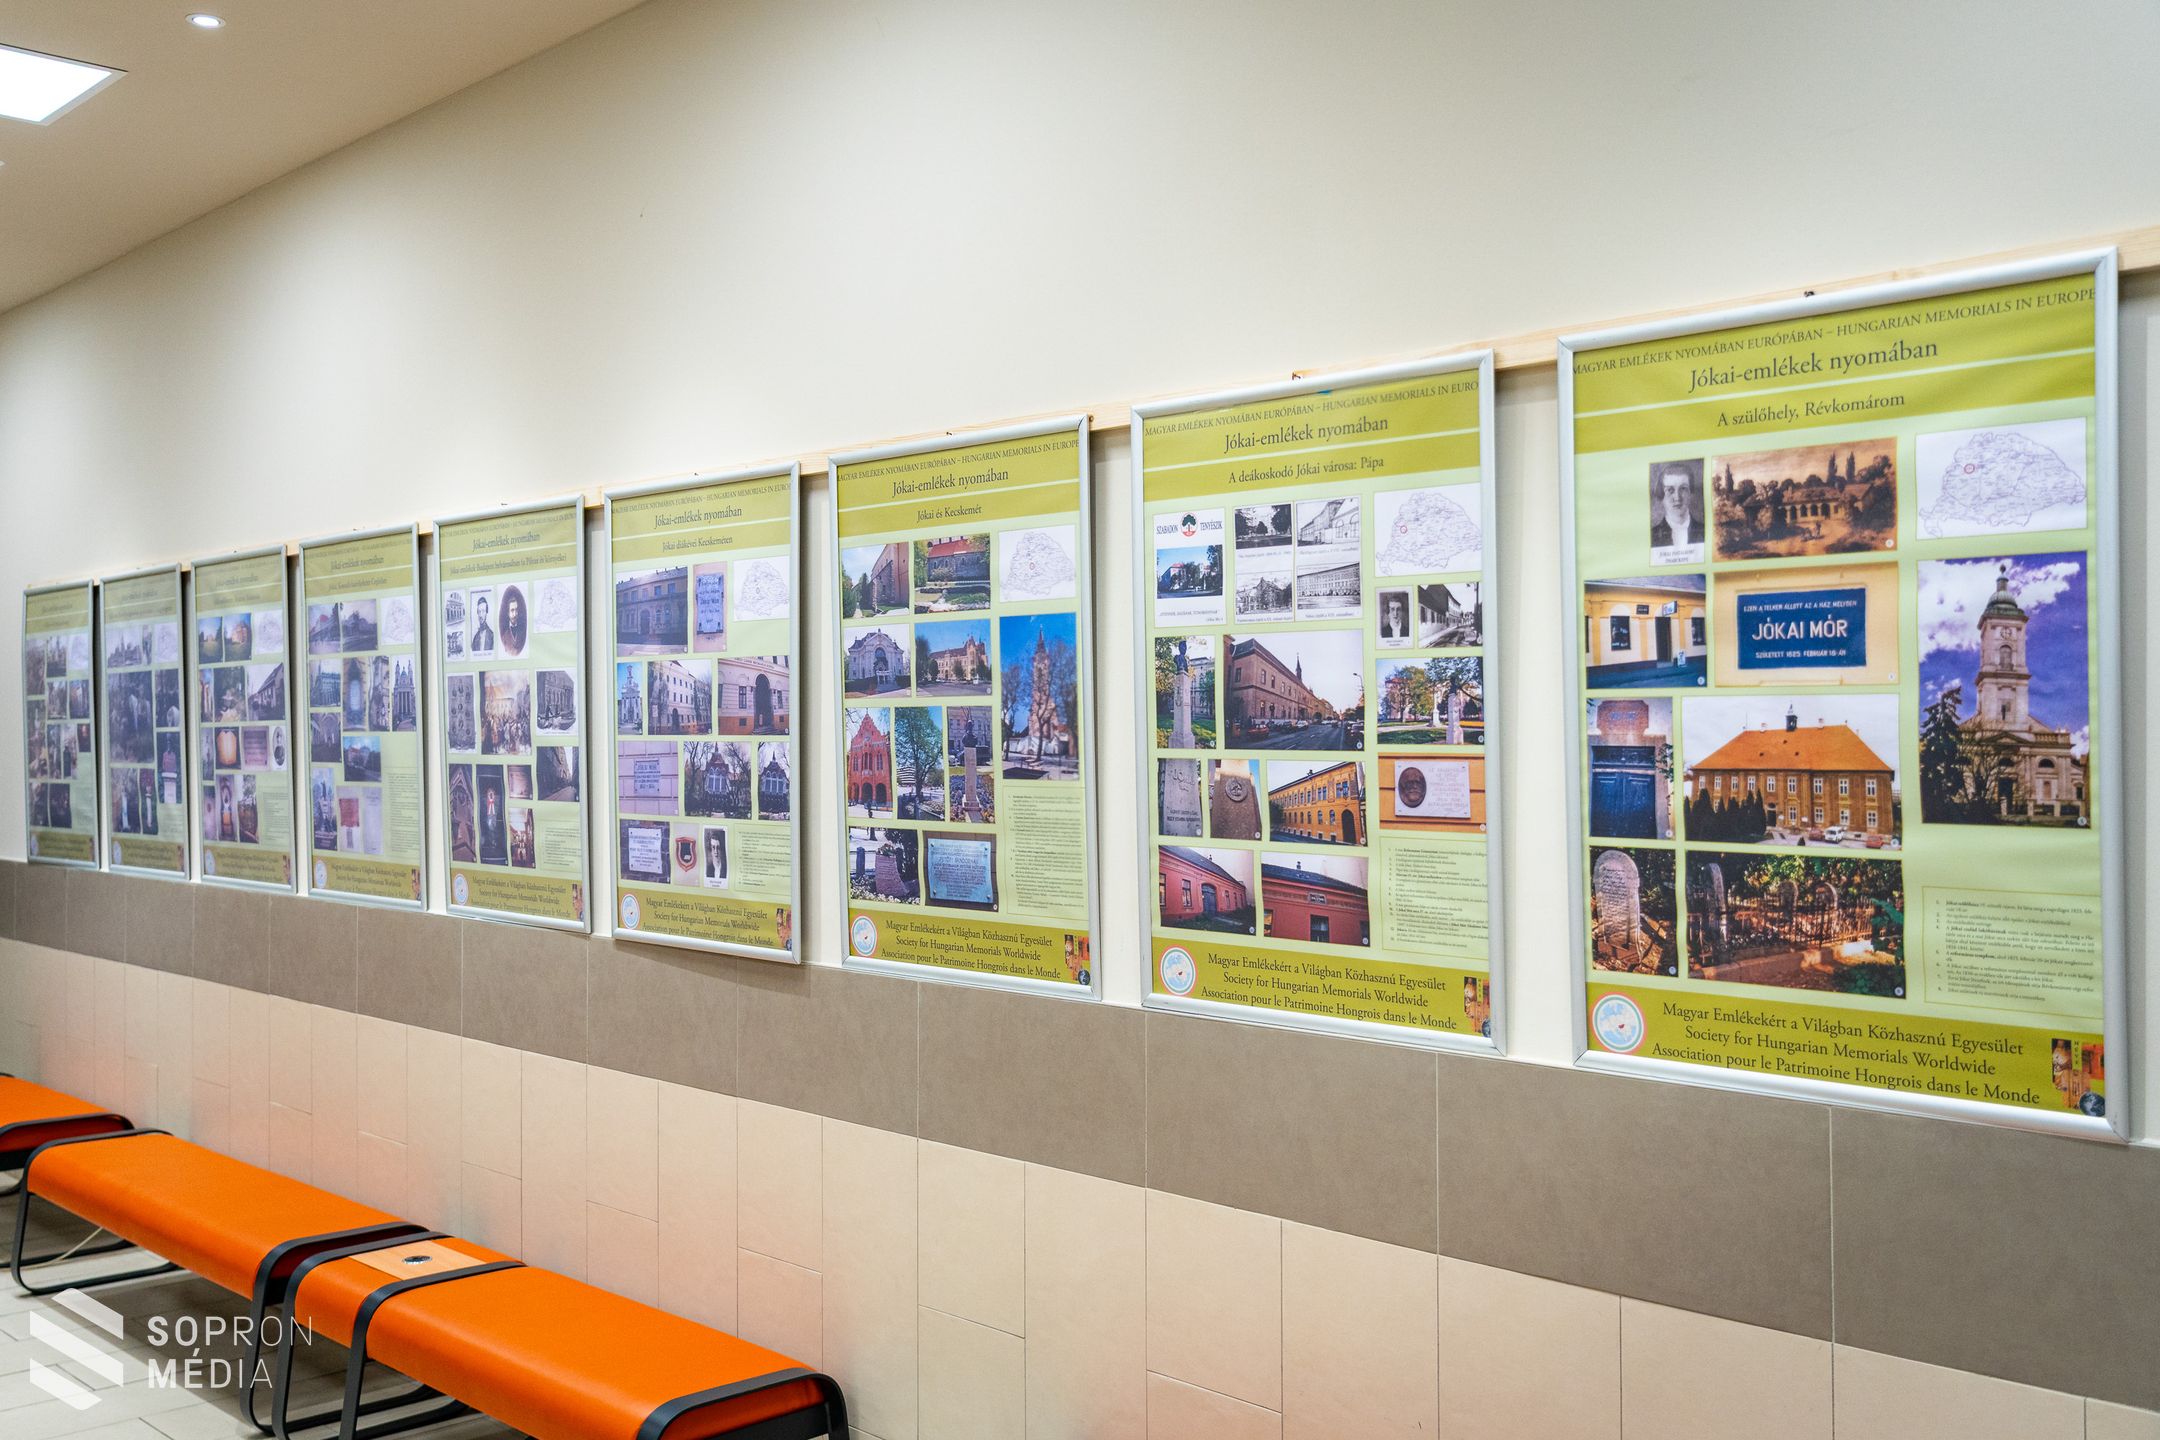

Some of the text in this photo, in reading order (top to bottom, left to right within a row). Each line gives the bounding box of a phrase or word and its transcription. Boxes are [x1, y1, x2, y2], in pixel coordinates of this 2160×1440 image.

[1573, 357, 1616, 375] MAGYAR
[1619, 349, 1672, 369] EMLÉKEK
[1675, 339, 1744, 360] NYOMÁBAN
[1747, 328, 1823, 350] EURÓPÁBAN
[1837, 314, 1921, 338] HUNGARIAN
[1926, 300, 2011, 323] MEMORIALS
[2016, 297, 2032, 311] IN
[2036, 288, 2095, 307] EUROPE
[1688, 339, 1938, 393] Jókai-emlékek nyomában
[1145, 424, 1176, 436] MAGYAR
[1178, 418, 1214, 431] EMLÉKEK
[1215, 411, 1262, 426] NYOMÁBAN
[1264, 405, 1314, 420] EURÓPÁBAN
[1322, 394, 1377, 412] HUNGARIAN
[1380, 386, 1436, 403] MEMORIALS
[1438, 385, 1448, 395] IN
[1717, 394, 1905, 427] A szülőhely, Révkomárom
[1224, 416, 1388, 454] Jókai-emlékek nyomában
[859, 468, 884, 479] EMLÉKEK
[885, 463, 919, 475] NYOMÁBAN
[961, 451, 1000, 463] HUNGARIAN
[1002, 445, 1042, 457] MEMORIALS
[1043, 443, 1050, 452] IN
[1228, 456, 1384, 483] A deákoskodó Jókai városa: Pápa
[892, 468, 1009, 498] Jókai-emlékek nyomában
[653, 505, 742, 529] Jókai-emlékek nyomában
[916, 503, 982, 523] Jókai és Kecskemét
[1752, 614, 1847, 640] JÓKAI MÓR
[885, 920, 908, 933] Magyar
[910, 922, 945, 935] Emlékekért
[951, 926, 980, 940] Világban
[982, 929, 1018, 943] Közhasznú
[1020, 933, 1052, 947] Egyesület
[896, 935, 1041, 960] Society for Hungarian Memorials Worldwide
[881, 948, 1061, 978] Association pour le Patrimoine Hongrois dans le Monde
[1208, 953, 1239, 968] Magyar
[1242, 956, 1291, 973] Emlékekért
[1301, 963, 1342, 980] Világban
[1345, 968, 1396, 985] Közhasznú
[1399, 974, 1446, 990] Egyesület
[1223, 972, 1428, 1007] Society for Hungarian Memorials Worldwide
[1201, 986, 1457, 1030] Association pour le Patrimoine Hongrois dans le Monde
[1663, 1002, 2023, 1055] Magyar Emlékekért a Világban Közhasznú Egyesület
[1685, 1026, 1996, 1075] Society for Hungarian Memorials Worldwide
[1652, 1042, 2040, 1104] Association pour le Patrimoine Hongrois dans le Monde
